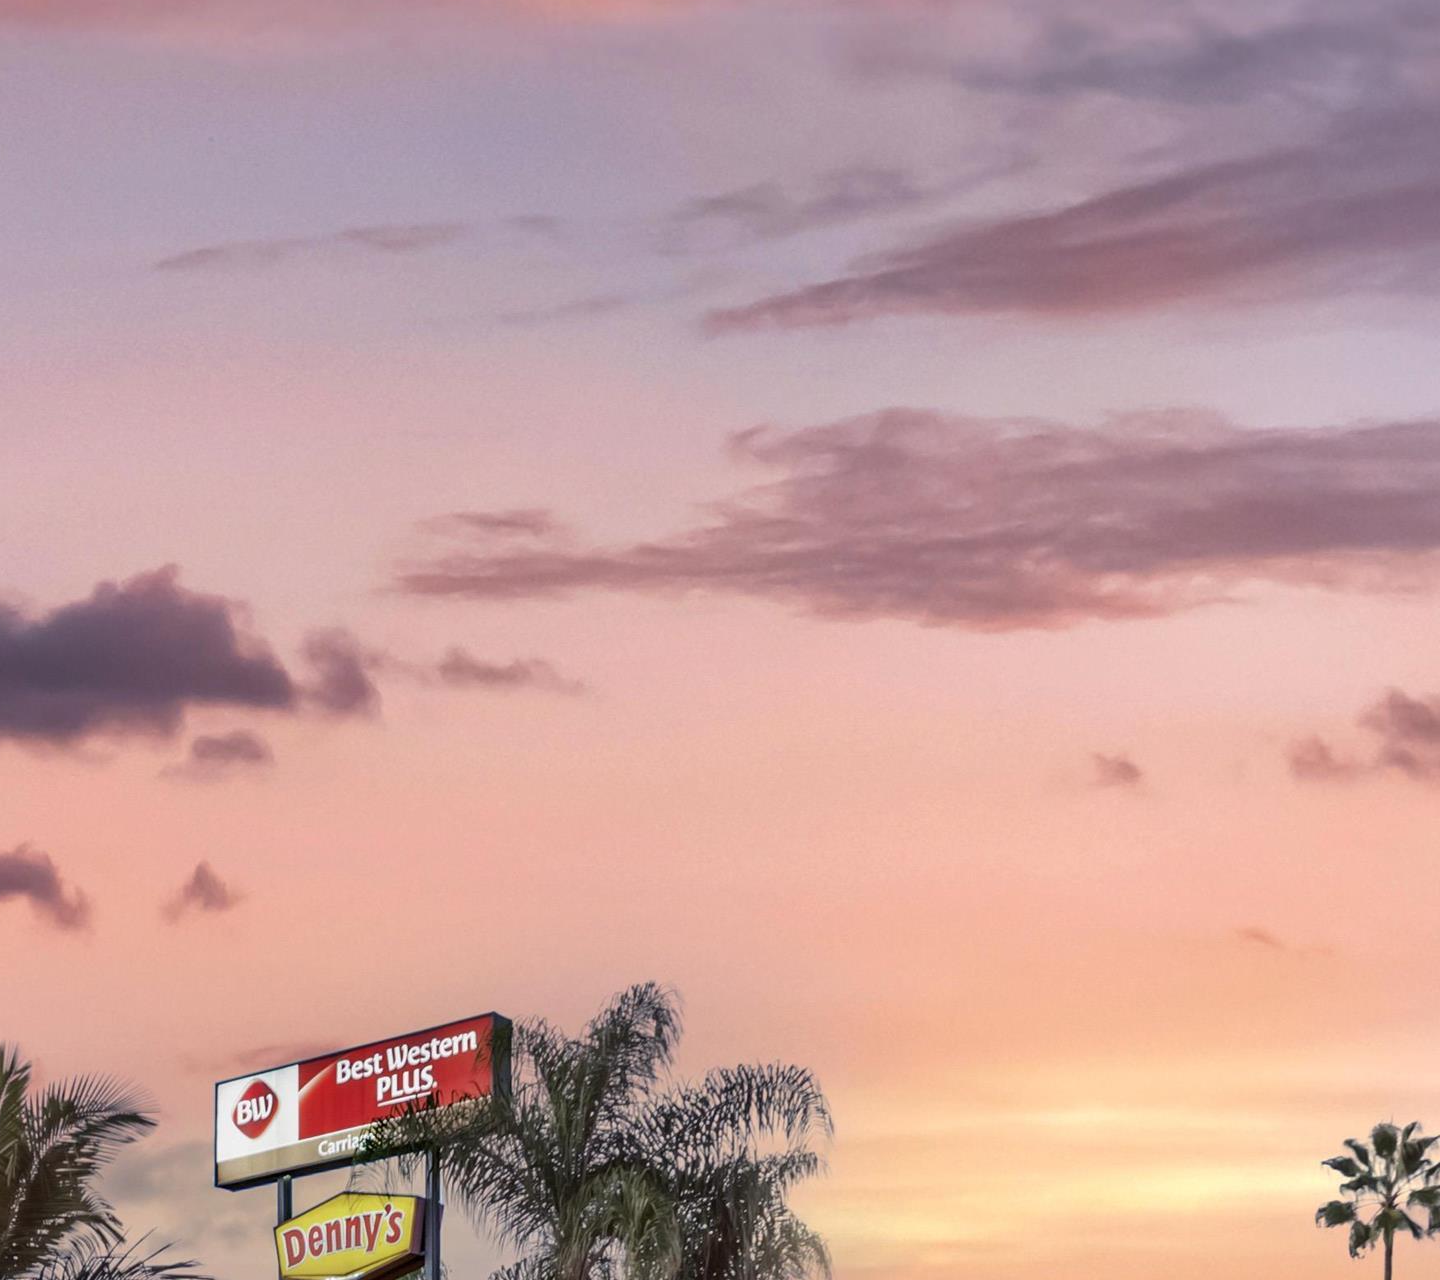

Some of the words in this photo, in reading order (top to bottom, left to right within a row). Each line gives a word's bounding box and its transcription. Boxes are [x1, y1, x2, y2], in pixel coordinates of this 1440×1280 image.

[336, 1053, 383, 1084] Best
[386, 1030, 478, 1071] Western
[237, 1093, 273, 1125] BW
[282, 1203, 404, 1269] Denny's
